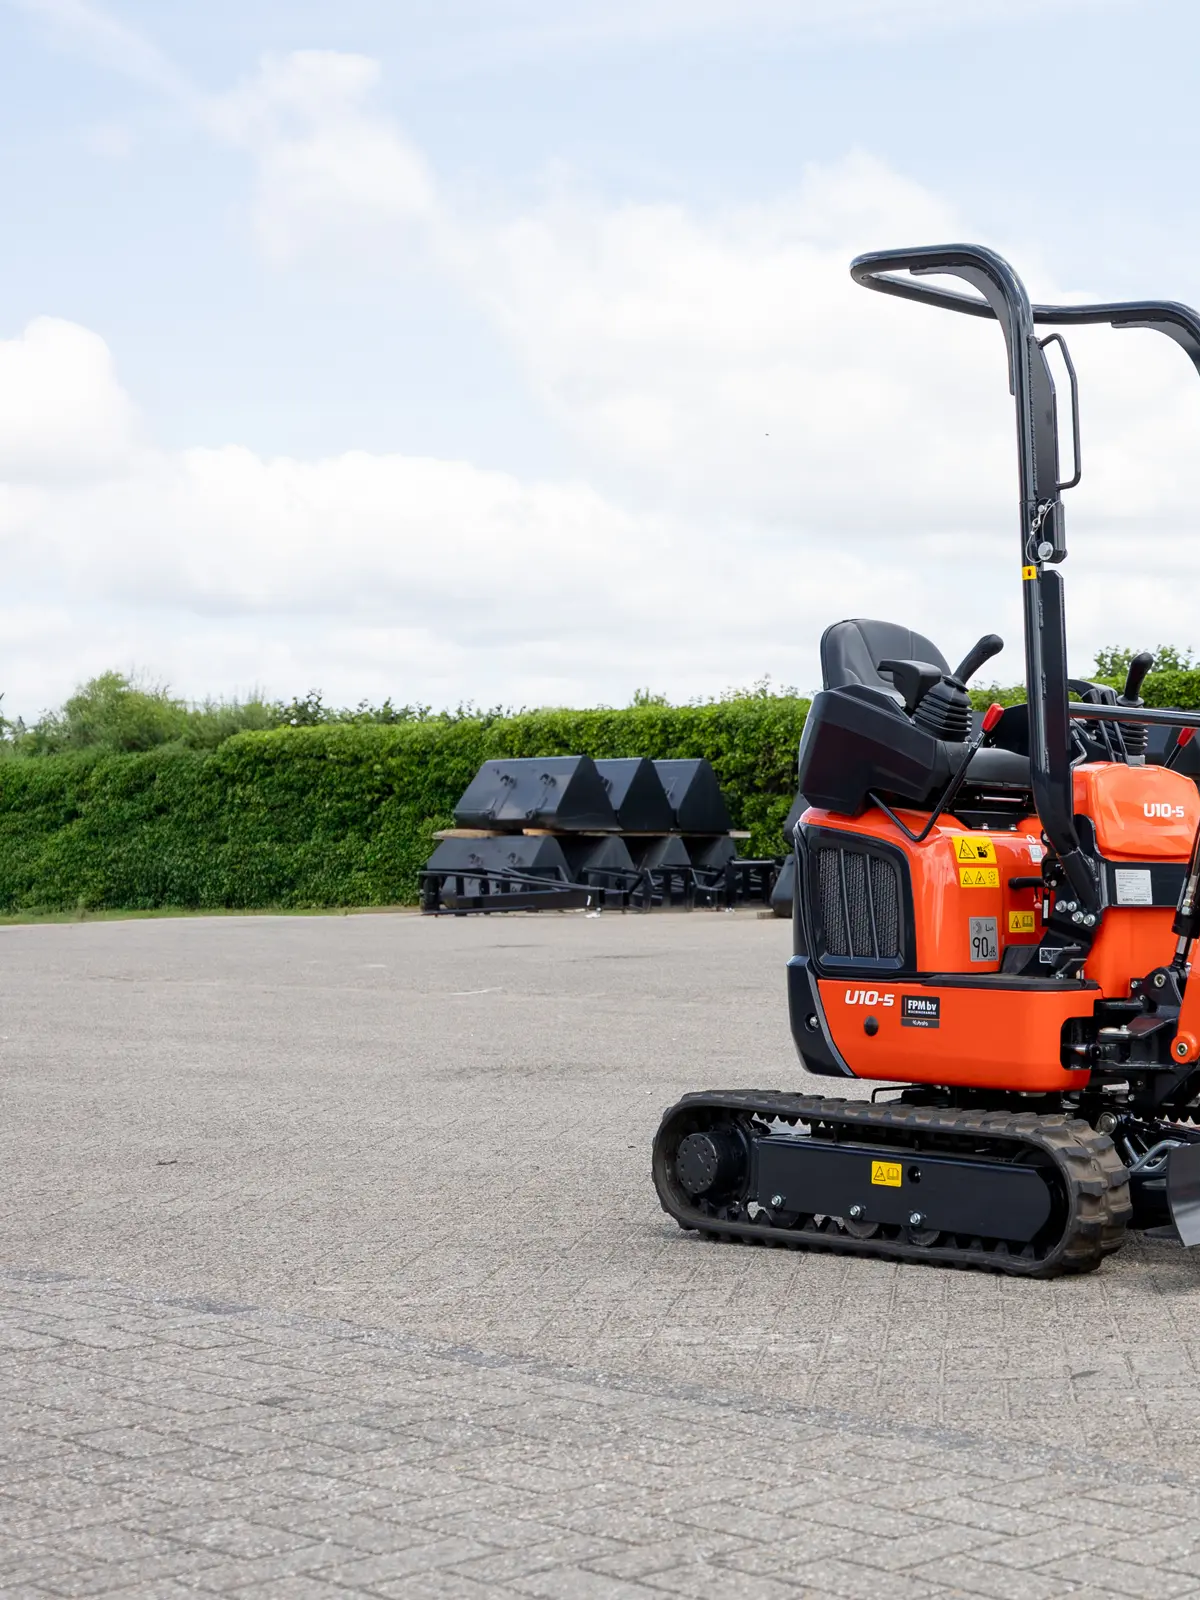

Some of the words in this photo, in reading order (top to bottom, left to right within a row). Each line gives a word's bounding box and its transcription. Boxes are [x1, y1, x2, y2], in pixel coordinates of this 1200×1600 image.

[1143, 803, 1185, 818] U10-5
[972, 936, 988, 958] 90
[845, 990, 895, 1006] U10-5
[907, 999, 926, 1010] FPM
[926, 1001, 937, 1011] bv
